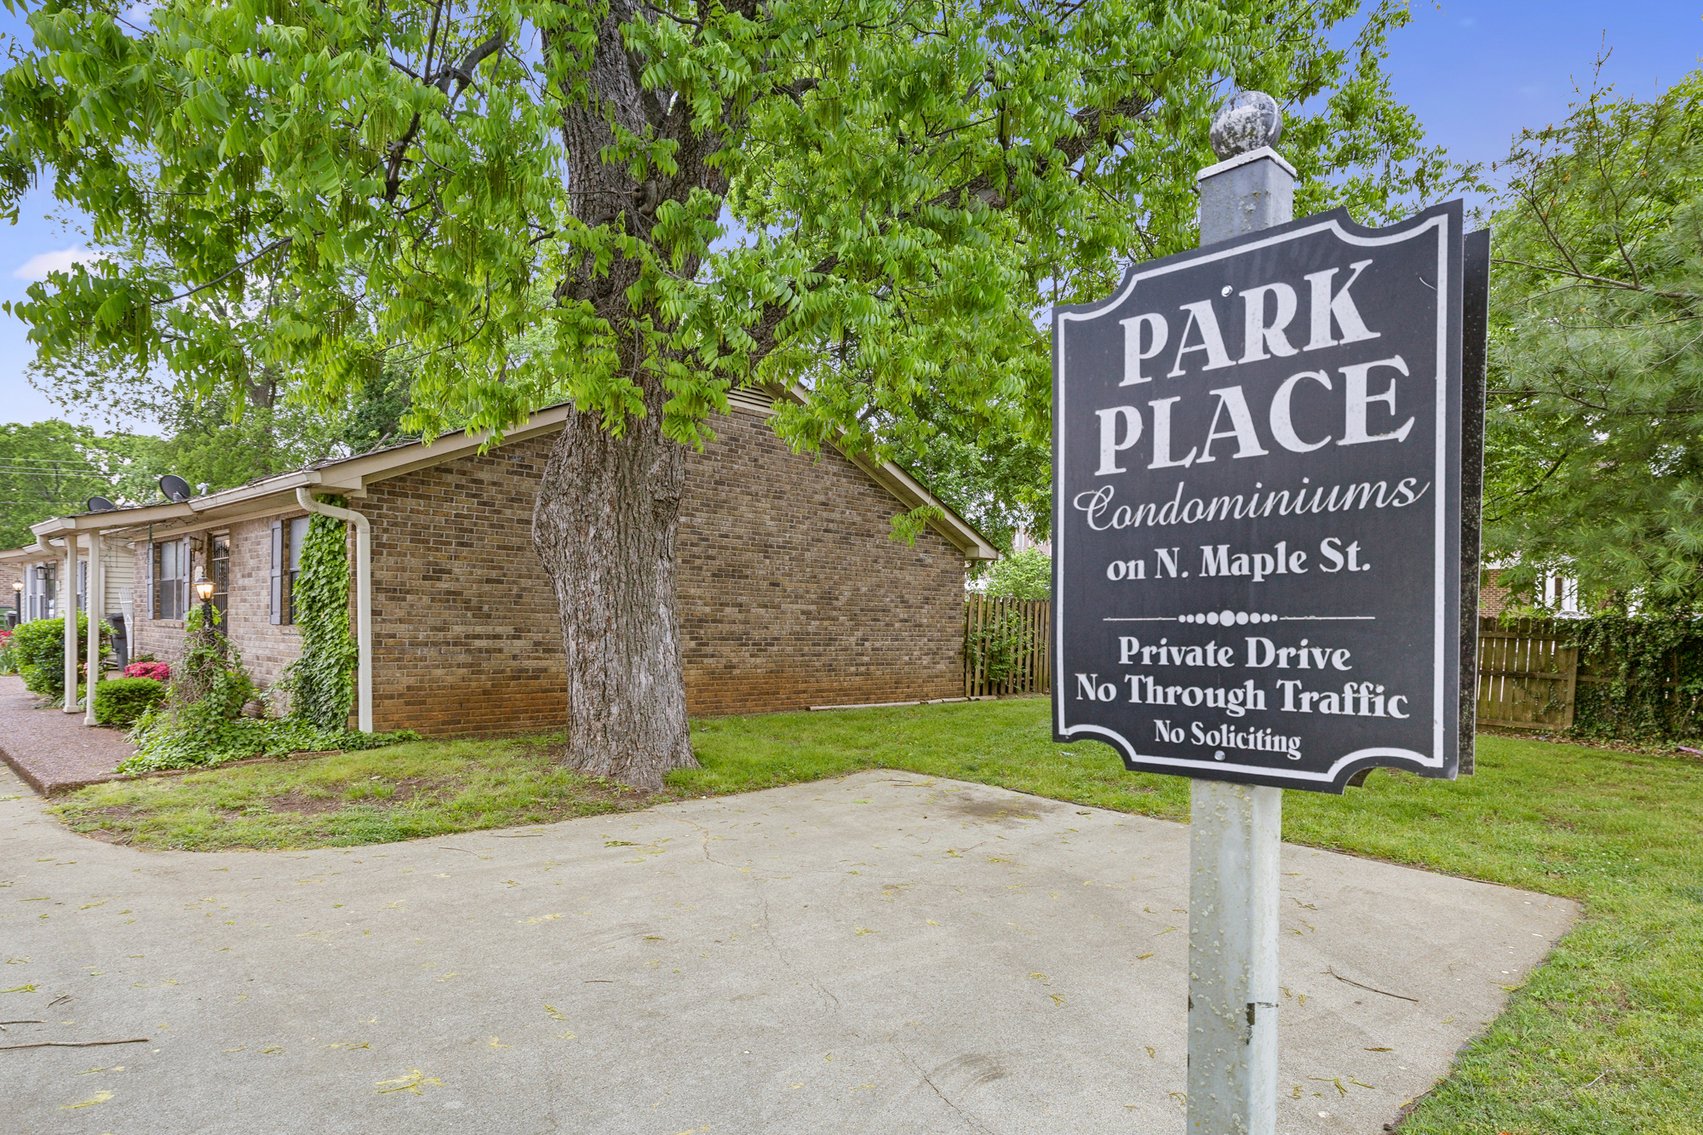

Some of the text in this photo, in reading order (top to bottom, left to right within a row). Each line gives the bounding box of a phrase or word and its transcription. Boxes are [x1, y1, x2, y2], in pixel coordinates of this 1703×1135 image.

[1118, 259, 1381, 387] PARK
[1094, 354, 1415, 476] PLACE
[1073, 477, 1431, 531] Condominiums
[1106, 537, 1371, 582] on N. Maple St.
[1118, 636, 1352, 671] Private Drive
[1075, 673, 1410, 719] No Through Traffic
[1154, 719, 1301, 760] No Soliciting
